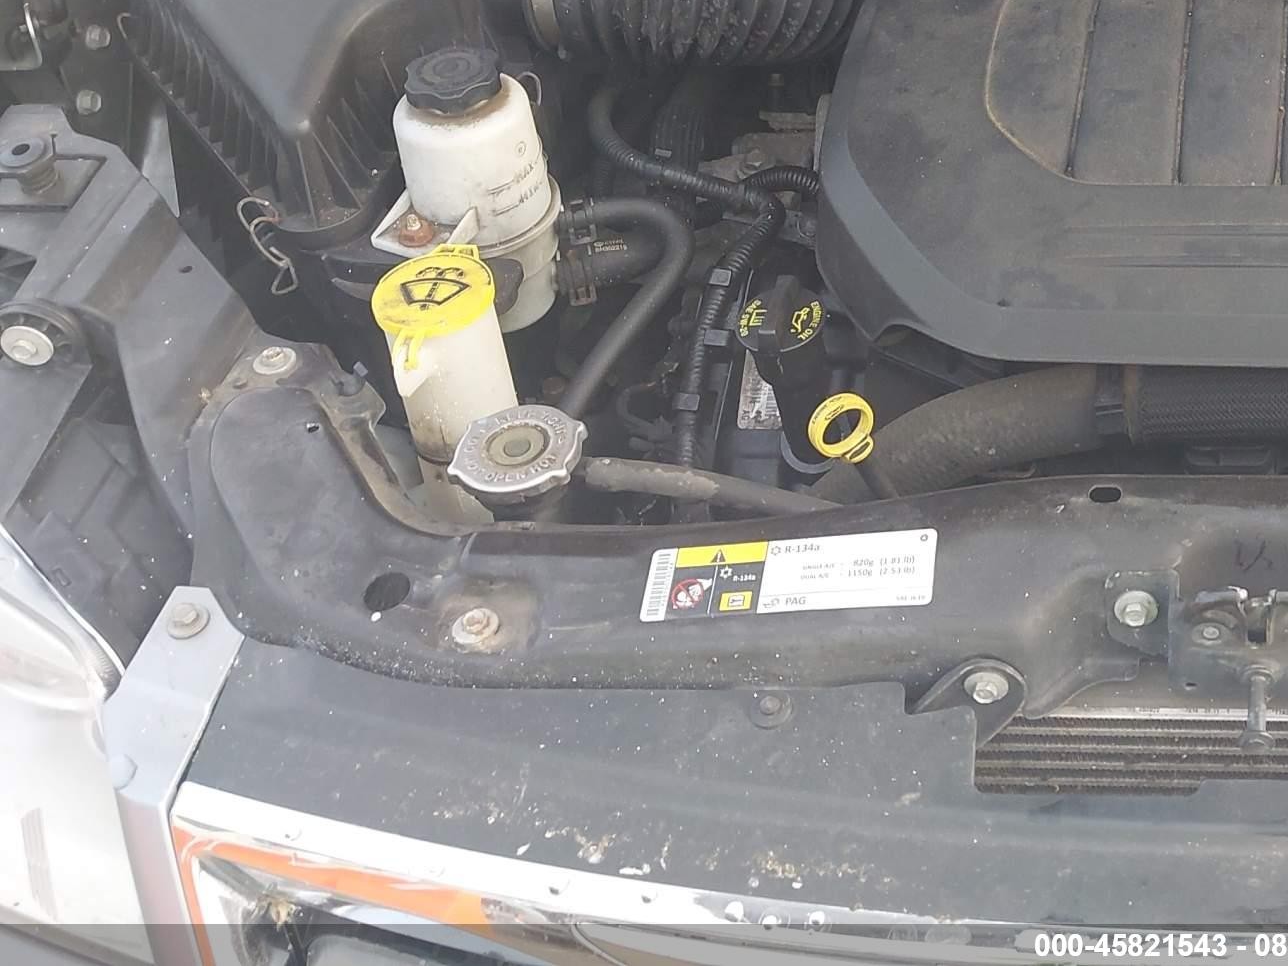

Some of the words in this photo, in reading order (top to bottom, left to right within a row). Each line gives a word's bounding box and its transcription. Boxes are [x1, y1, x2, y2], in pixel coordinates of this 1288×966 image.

[744, 299, 762, 314] SAE
[810, 300, 823, 328] ENGINE
[797, 327, 814, 341] OIL
[484, 472, 528, 483] OPEN
[784, 542, 820, 554] R-134a
[853, 559, 875, 568] 820g
[848, 569, 873, 578] 1150g
[785, 596, 807, 606] PAG
